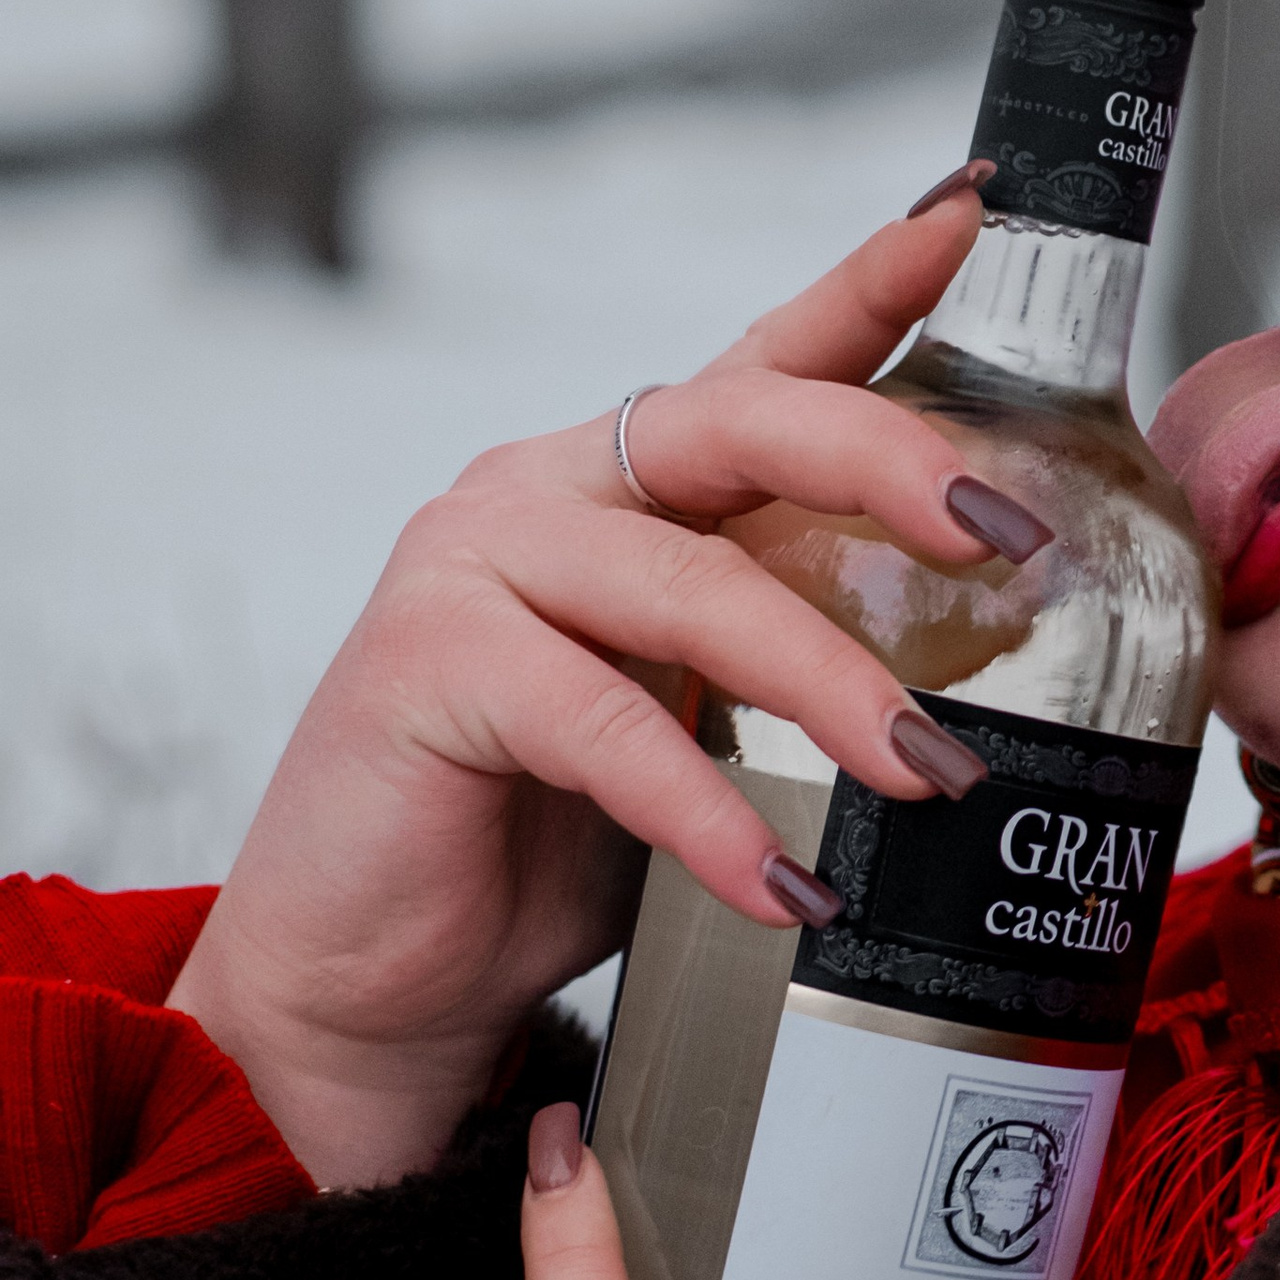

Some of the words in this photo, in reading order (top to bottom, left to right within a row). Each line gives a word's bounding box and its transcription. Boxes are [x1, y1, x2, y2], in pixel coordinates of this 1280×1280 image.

[1105, 91, 1178, 139] GRAN
[1098, 136, 1167, 171] castillo
[999, 806, 1159, 895] GRAN
[985, 893, 1132, 954] castillo
